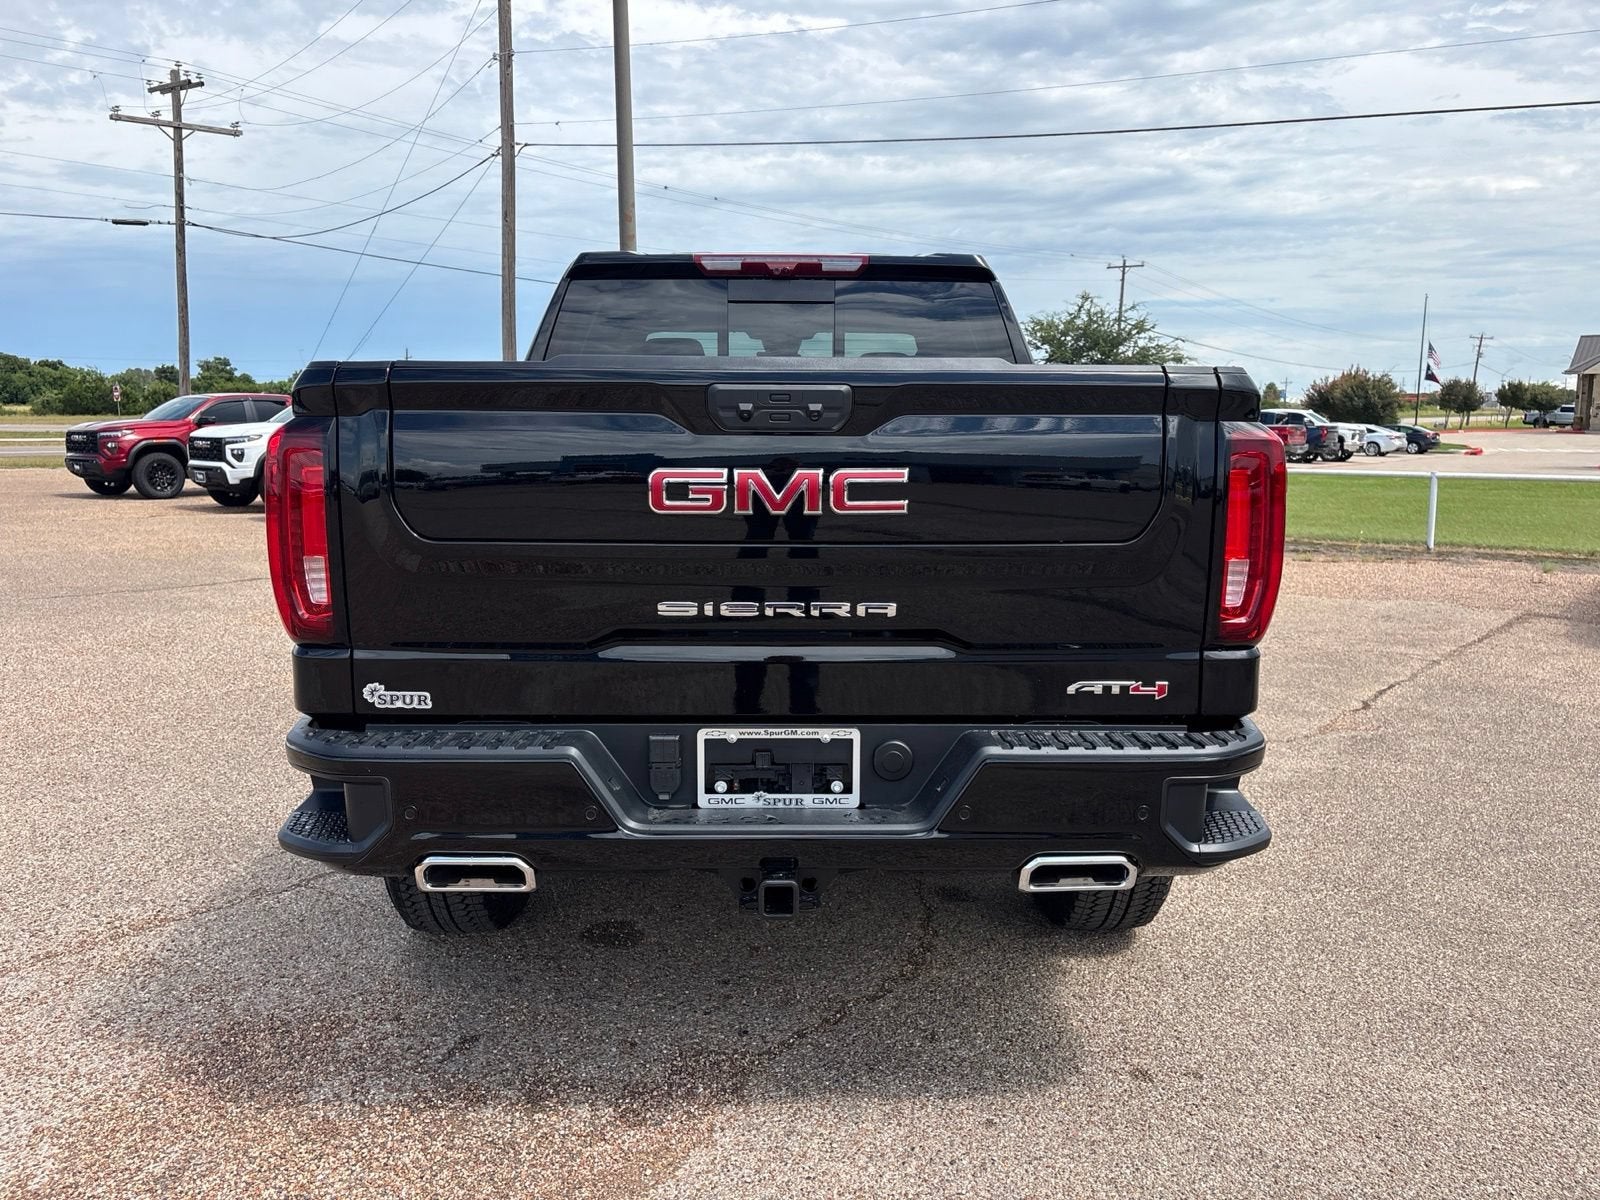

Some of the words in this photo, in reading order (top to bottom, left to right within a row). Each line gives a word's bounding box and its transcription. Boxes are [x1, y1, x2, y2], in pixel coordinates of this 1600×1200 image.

[648, 467, 909, 515] GMC
[657, 601, 897, 618] SIERRA
[1066, 680, 1169, 700] AT4
[377, 694, 429, 706] SPUR
[738, 729, 820, 737] www.SpurGM.com
[707, 797, 746, 805] GMC
[762, 797, 805, 807] SPUR
[812, 797, 850, 805] GMC
